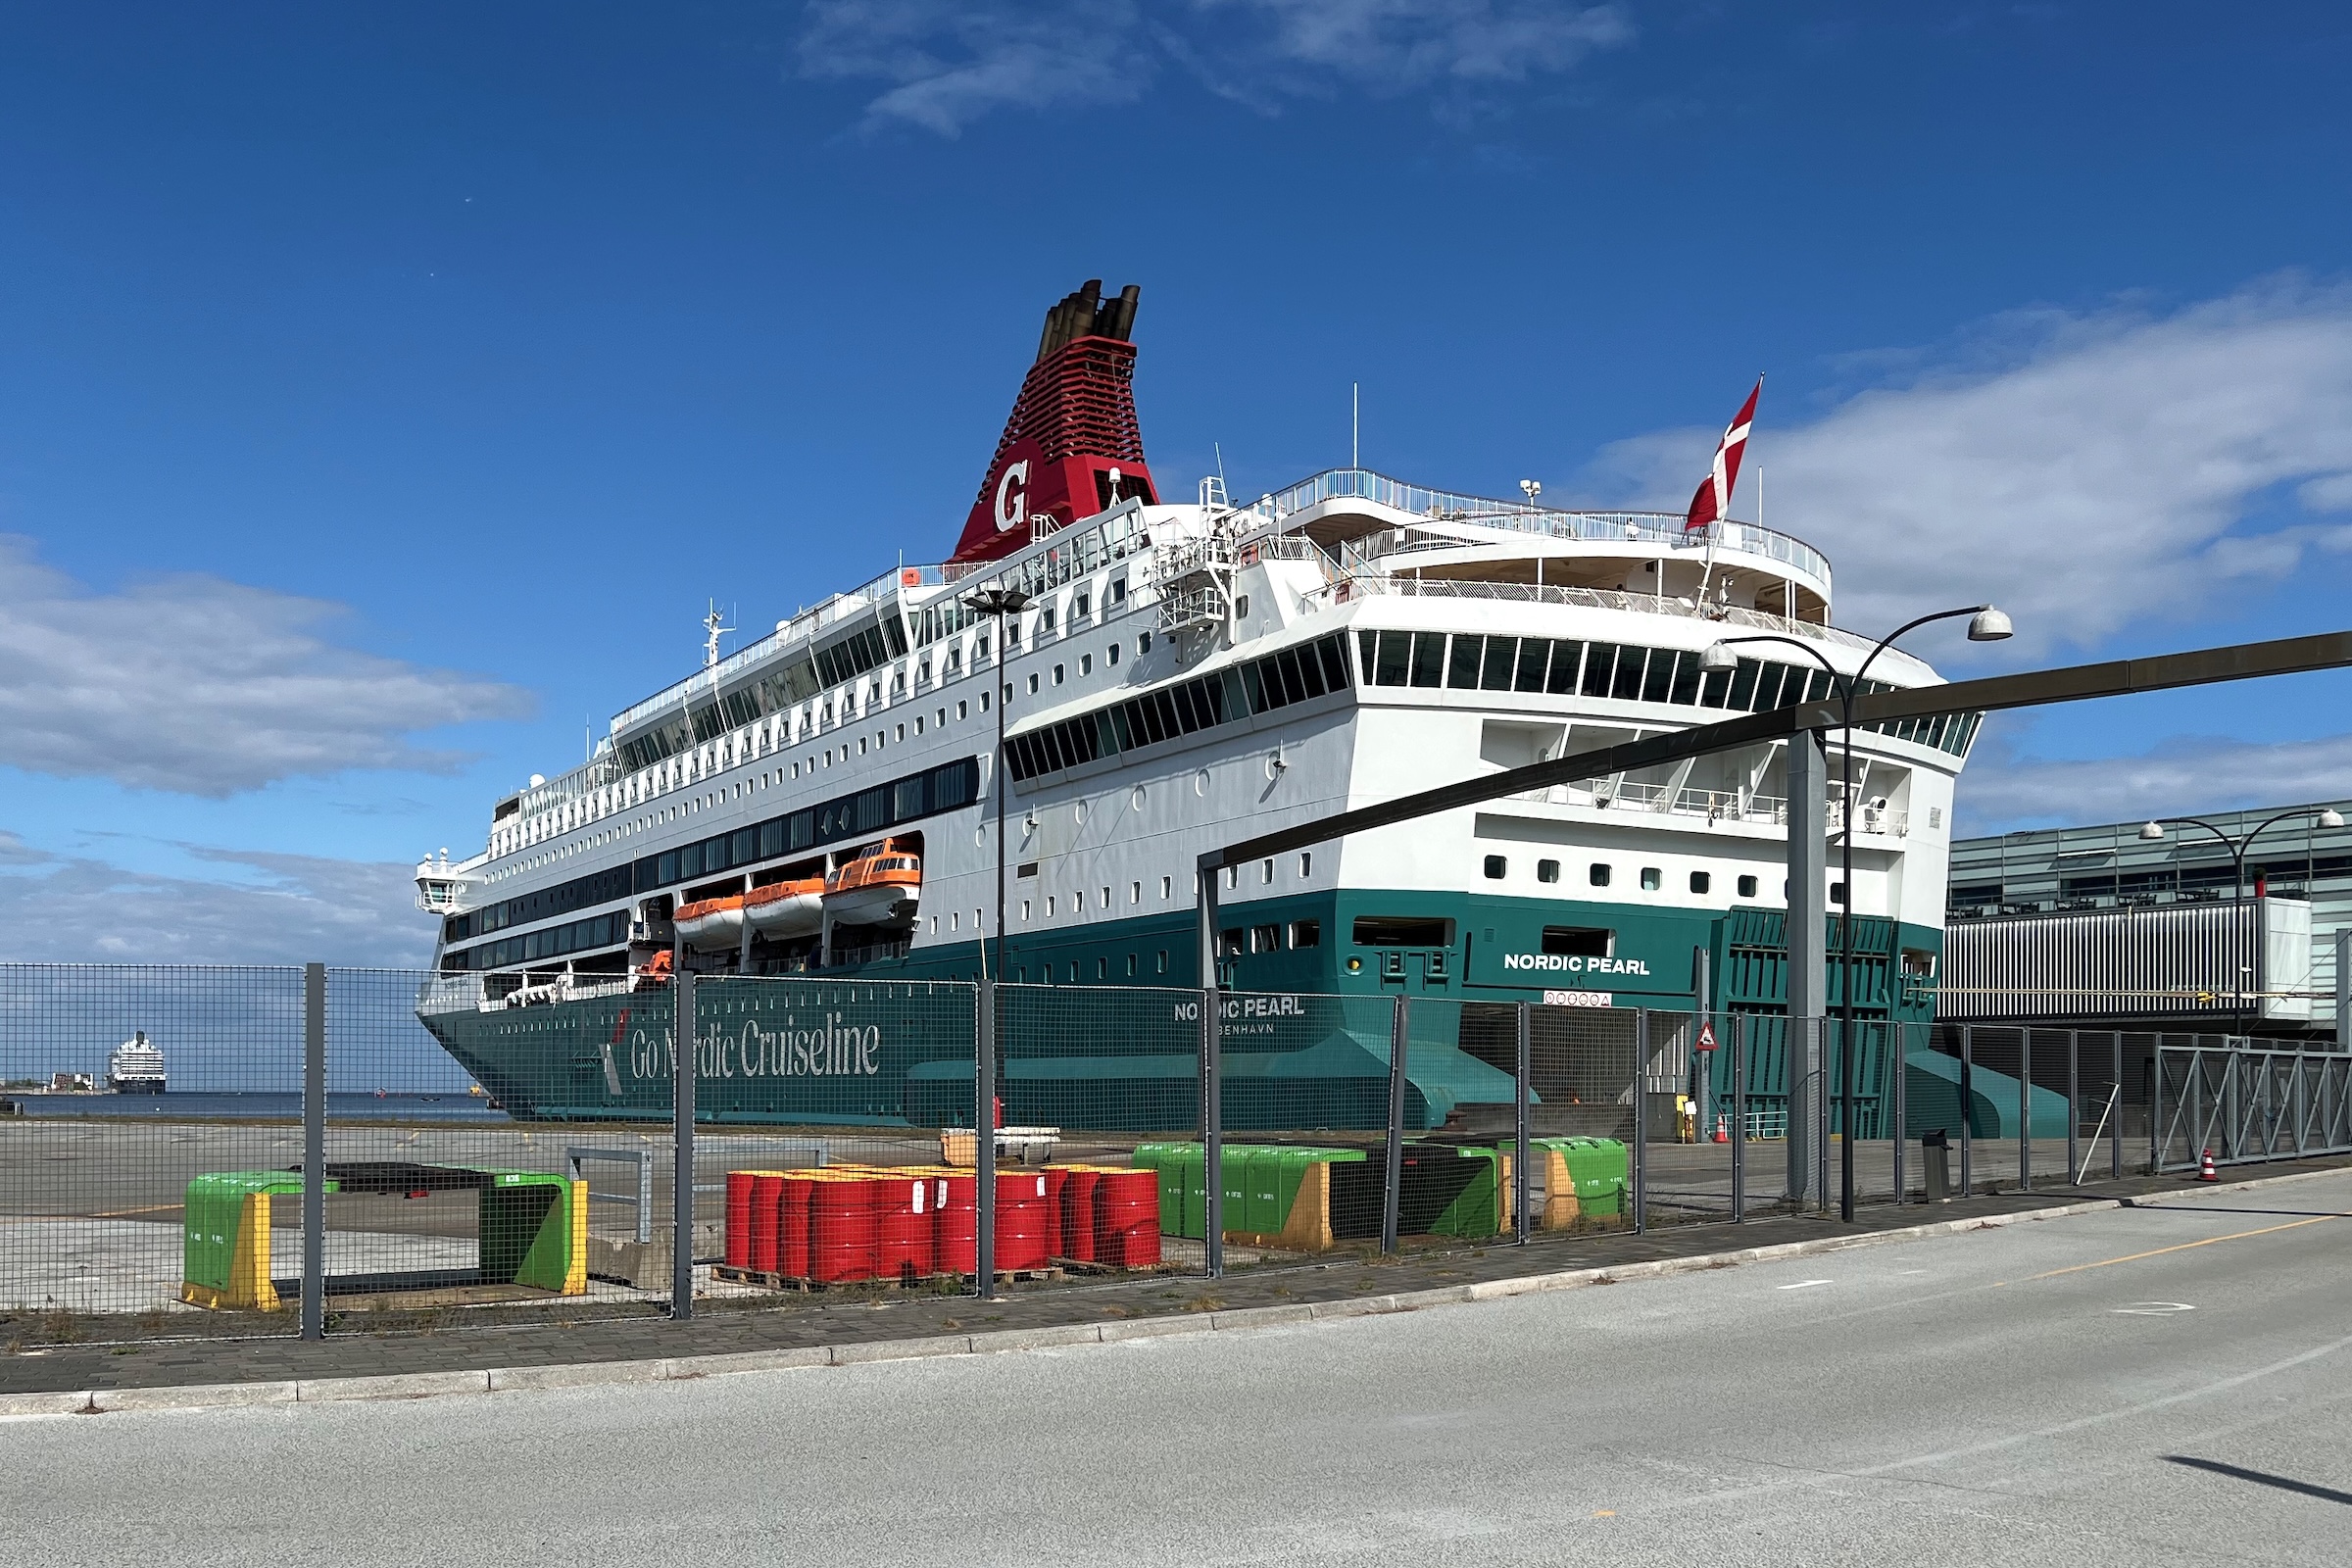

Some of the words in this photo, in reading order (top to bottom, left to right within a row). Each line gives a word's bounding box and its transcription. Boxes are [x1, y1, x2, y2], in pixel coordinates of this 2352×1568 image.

[995, 459, 1028, 532] G
[1504, 954, 1583, 972] NORDIC
[1587, 957, 1650, 976] PEARL
[1174, 1000, 1240, 1021] NOIC
[1245, 996, 1305, 1018] PEARL
[1217, 1023, 1274, 1036] BENHAVN
[631, 1028, 659, 1078] Go
[663, 1021, 736, 1078] Nrdic
[741, 1010, 880, 1077] Cruiseline
